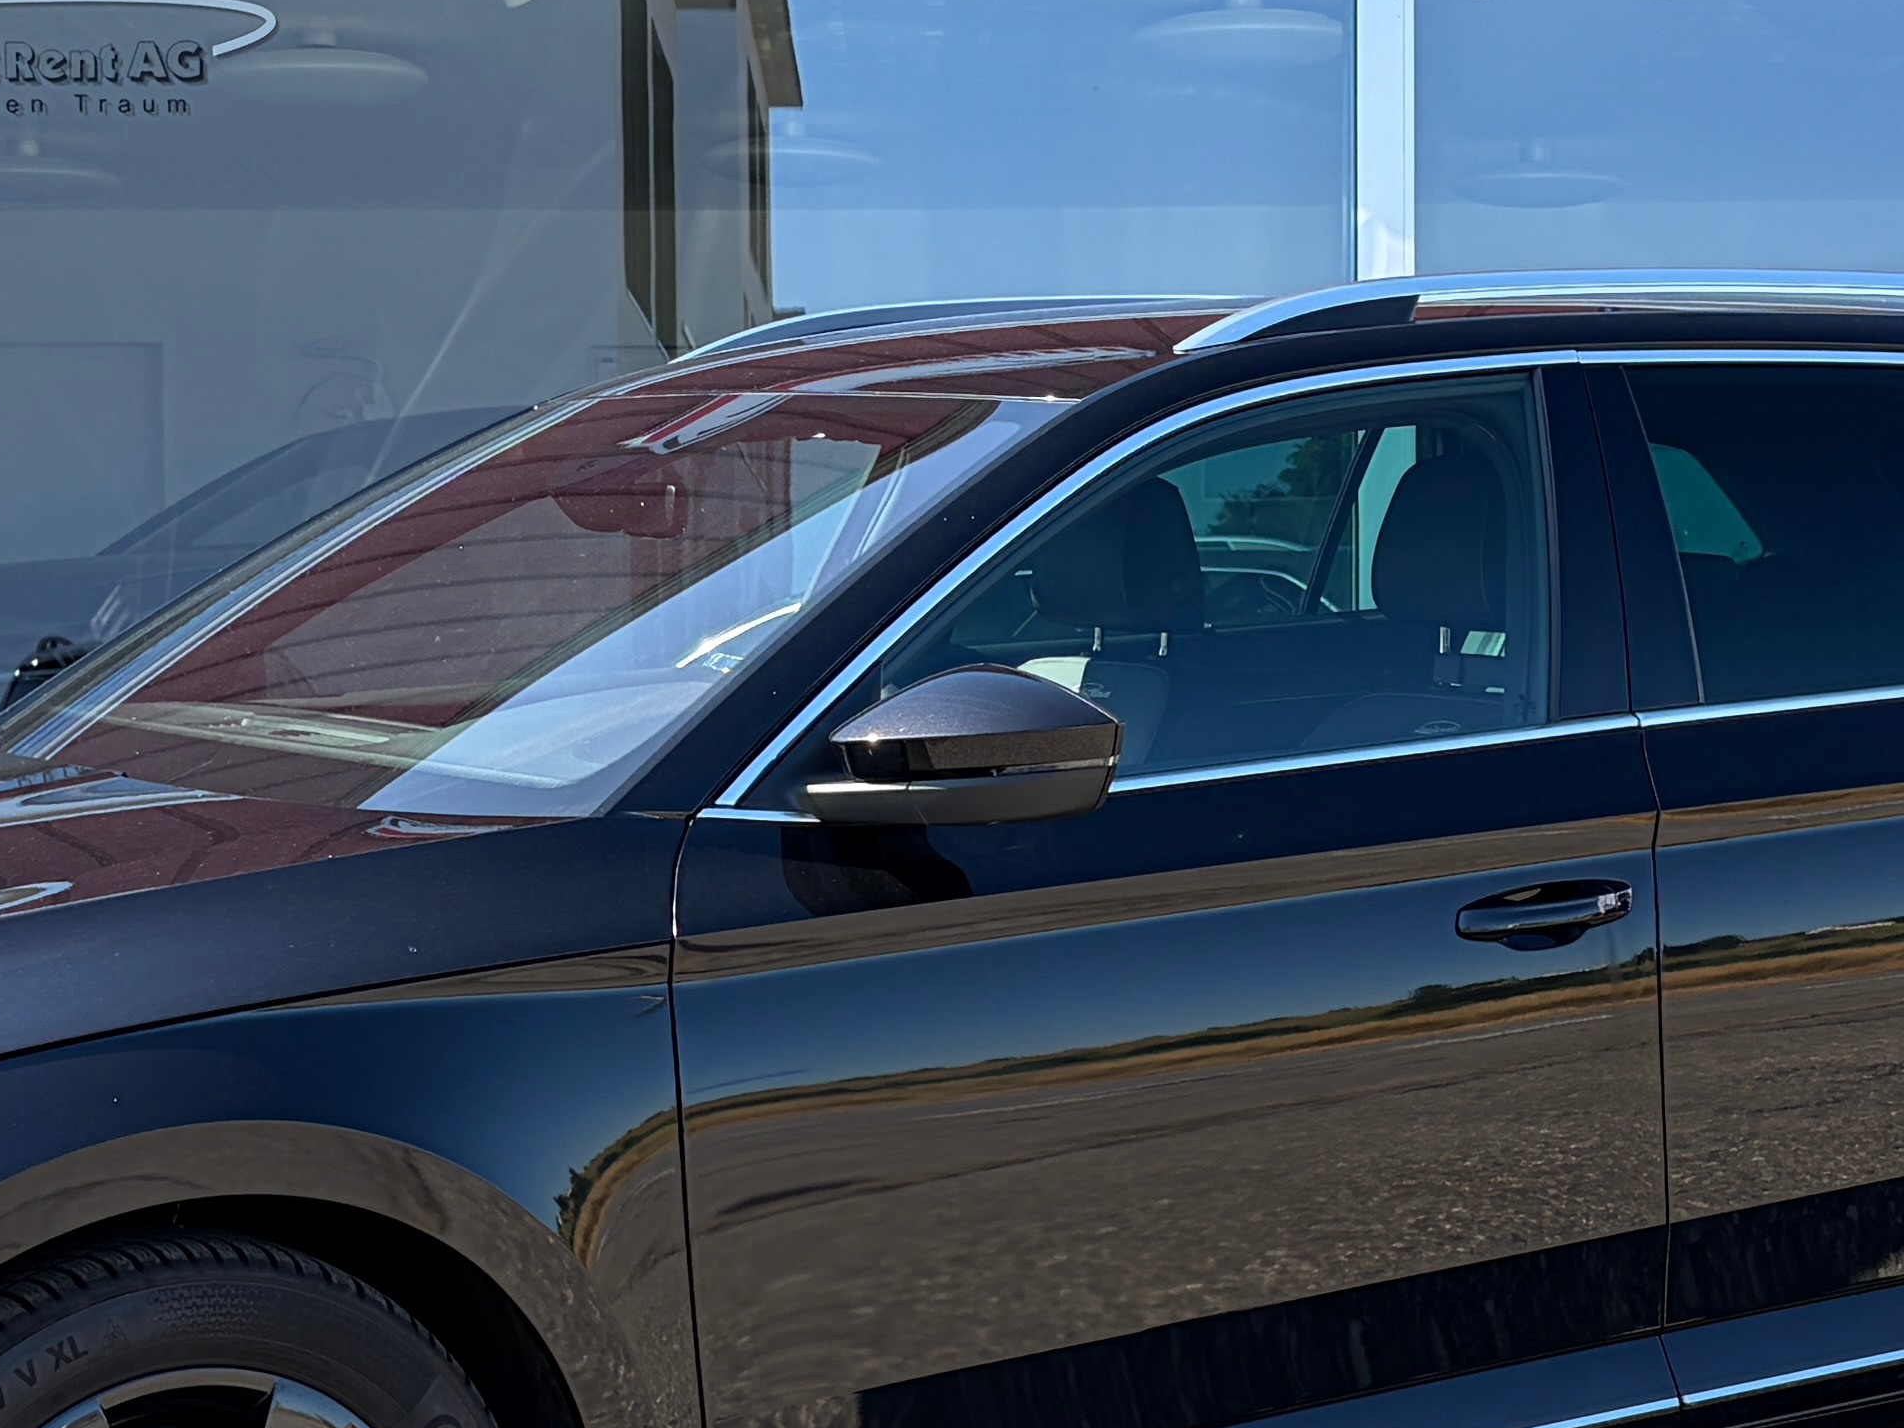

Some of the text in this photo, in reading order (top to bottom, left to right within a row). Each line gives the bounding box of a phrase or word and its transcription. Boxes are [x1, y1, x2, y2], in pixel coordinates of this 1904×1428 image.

[3, 40, 119, 83] Rent
[127, 39, 205, 83] AG
[74, 93, 190, 116] Traum
[13, 1358, 37, 1388] V
[46, 1335, 89, 1371] XL
